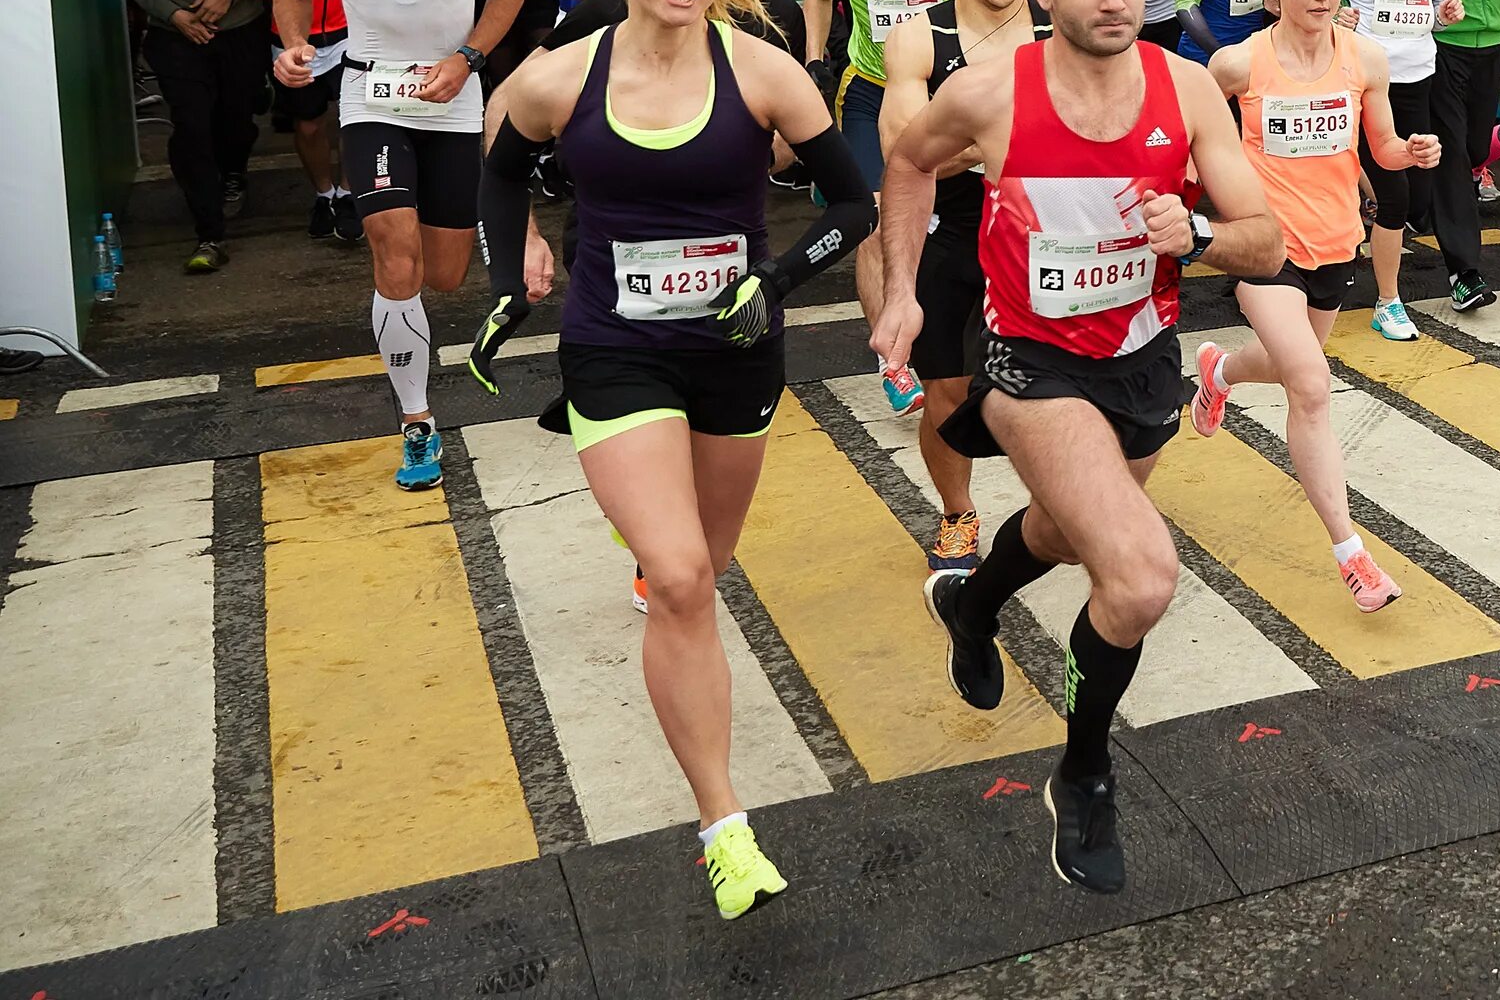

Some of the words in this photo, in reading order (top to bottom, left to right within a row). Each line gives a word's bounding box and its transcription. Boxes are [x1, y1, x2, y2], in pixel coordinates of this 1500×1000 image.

[1394, 12, 1431, 25] 43267
[1293, 114, 1348, 134] 51203
[661, 265, 739, 295] 42316
[1073, 258, 1147, 289] 40841
